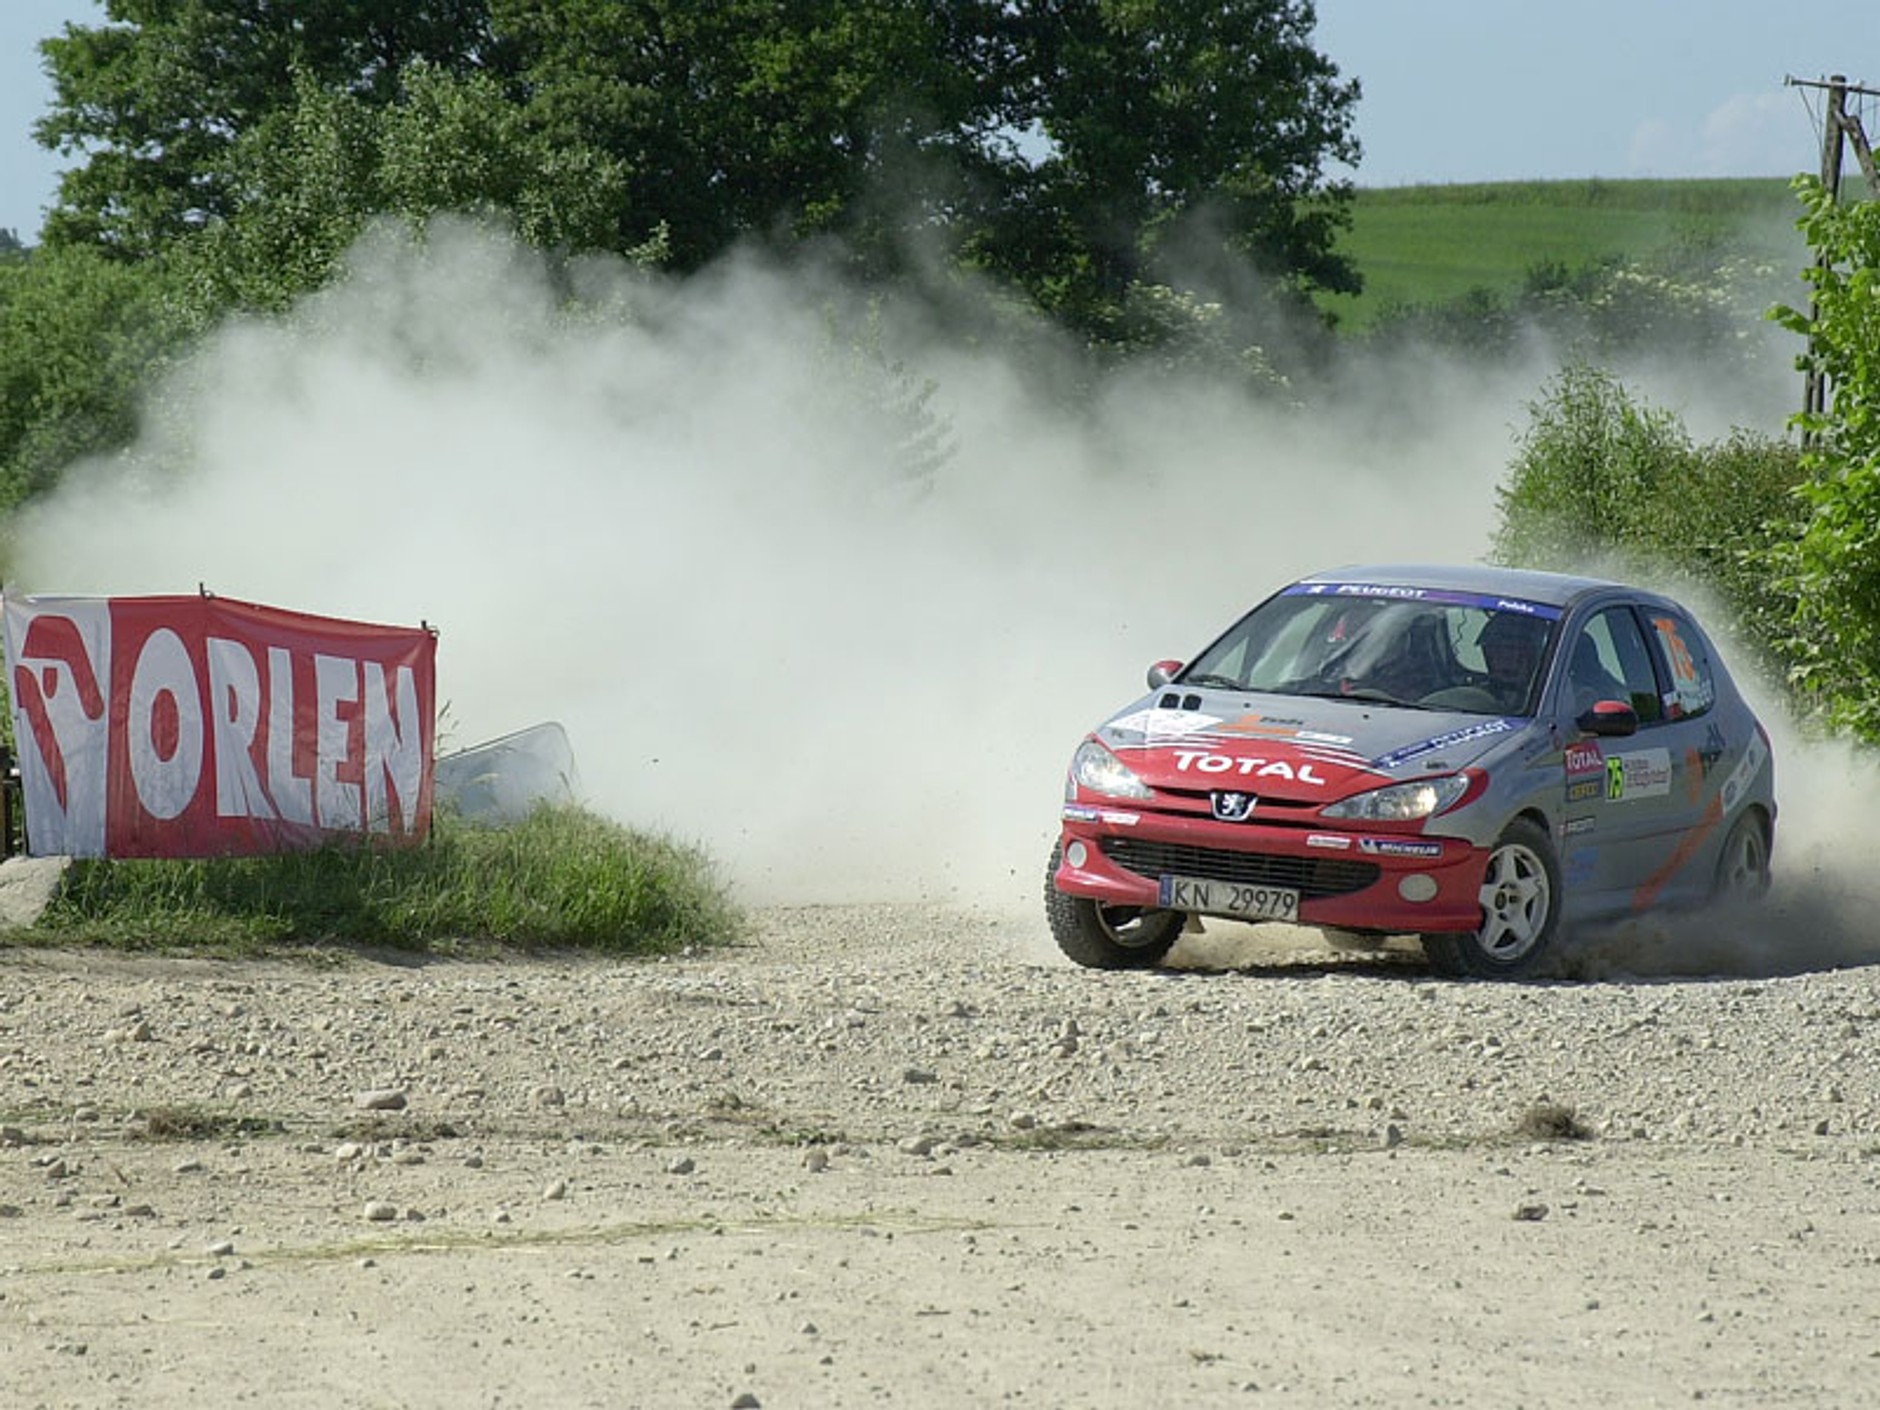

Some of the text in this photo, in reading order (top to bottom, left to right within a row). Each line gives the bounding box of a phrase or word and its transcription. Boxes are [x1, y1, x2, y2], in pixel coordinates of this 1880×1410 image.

[1336, 584, 1428, 600] PEUGEOT
[127, 626, 424, 836] ORLEN
[1173, 750, 1326, 786] TOTAL
[1564, 749, 1603, 770] TOTAL
[1173, 880, 1297, 917] KN 29979
